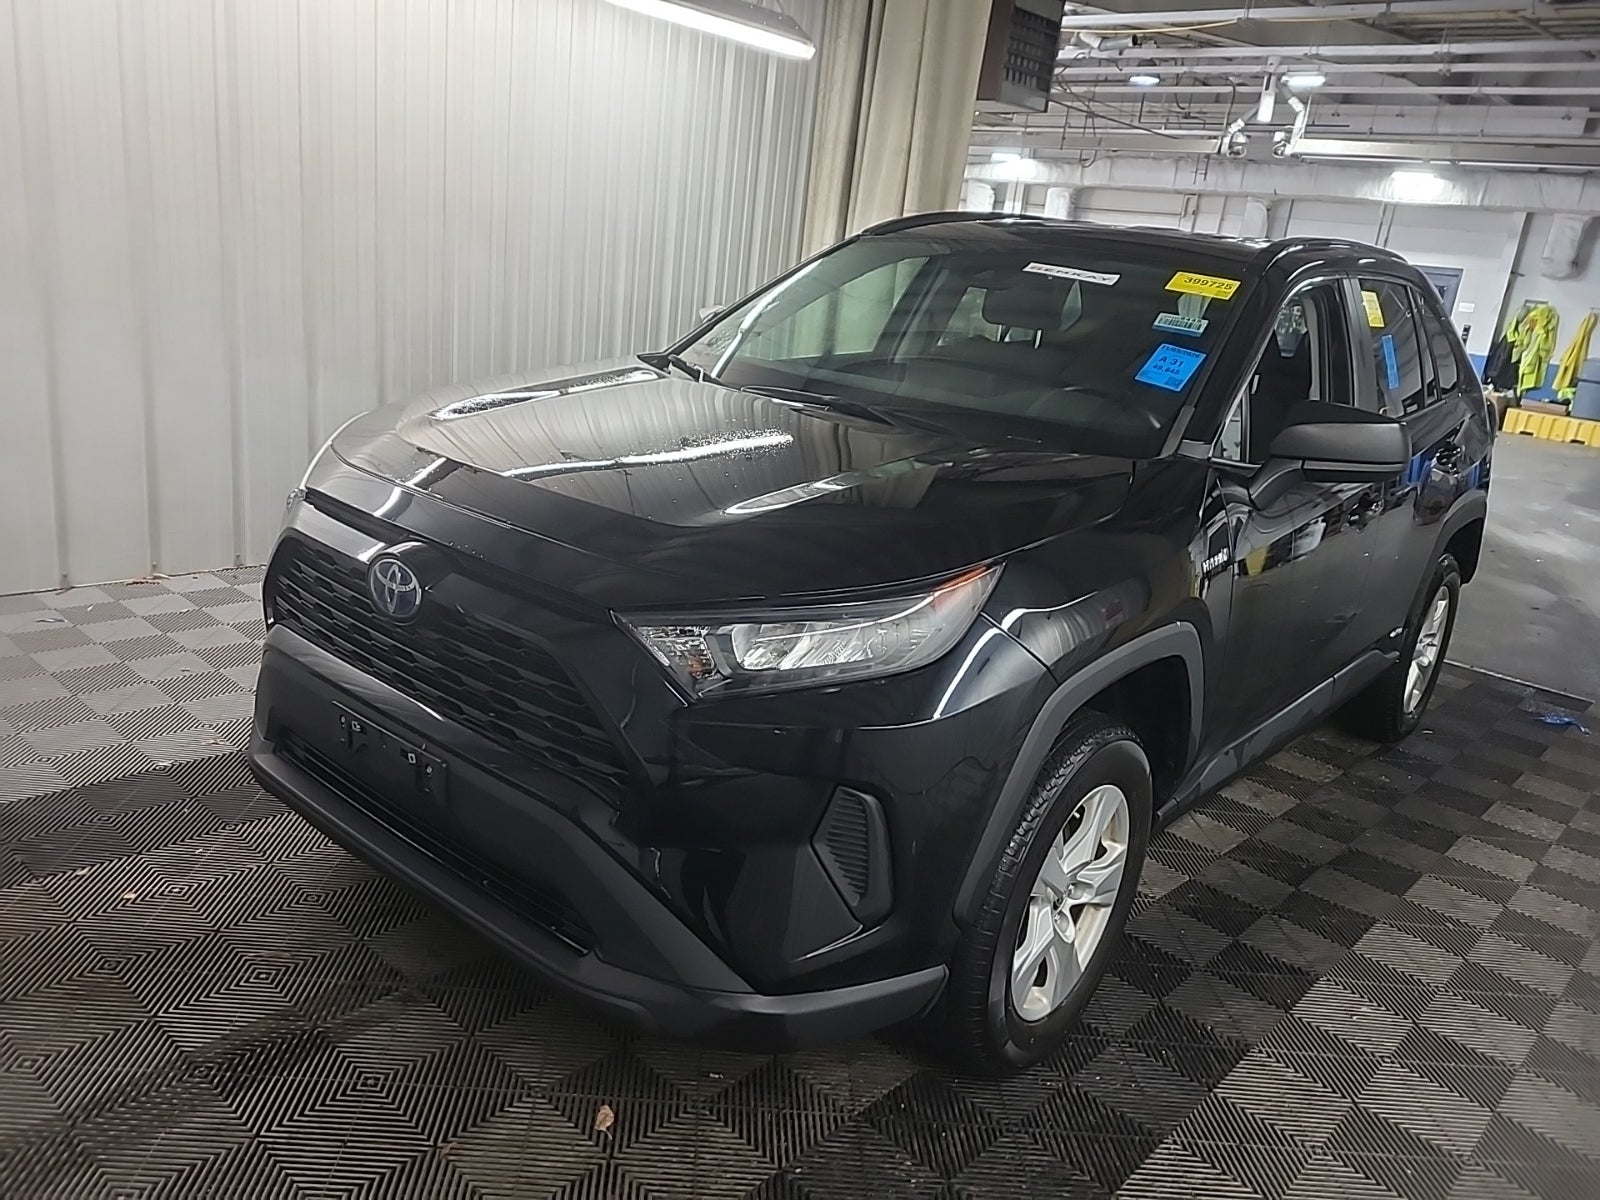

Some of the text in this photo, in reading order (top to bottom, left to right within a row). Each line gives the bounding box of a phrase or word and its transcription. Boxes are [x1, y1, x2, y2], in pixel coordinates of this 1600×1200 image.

[1183, 276, 1234, 290] 399725
[1159, 355, 1184, 367] A 31
